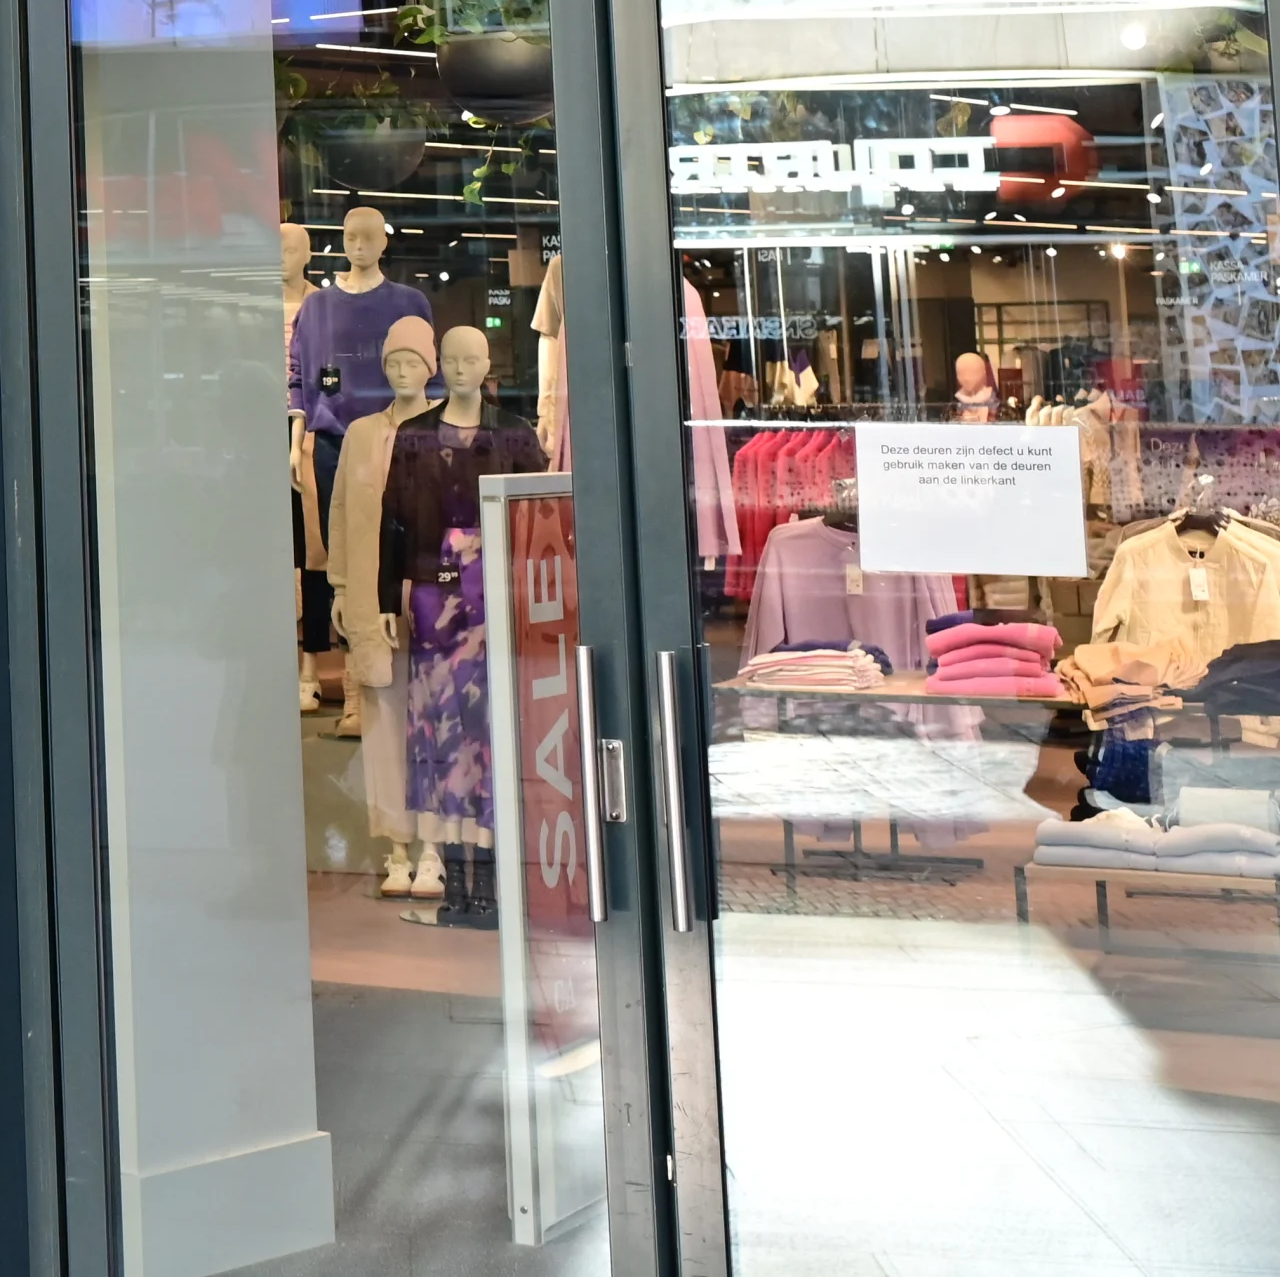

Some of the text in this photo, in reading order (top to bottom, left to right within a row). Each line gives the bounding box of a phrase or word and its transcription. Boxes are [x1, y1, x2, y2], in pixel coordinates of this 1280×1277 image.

[880, 444, 1053, 458] Deze deuren zijn defect u kunt
[883, 459, 1052, 472] gebruik maken van de deuren
[918, 475, 1017, 486] aan de linkerkant
[526, 554, 577, 890] SALE
